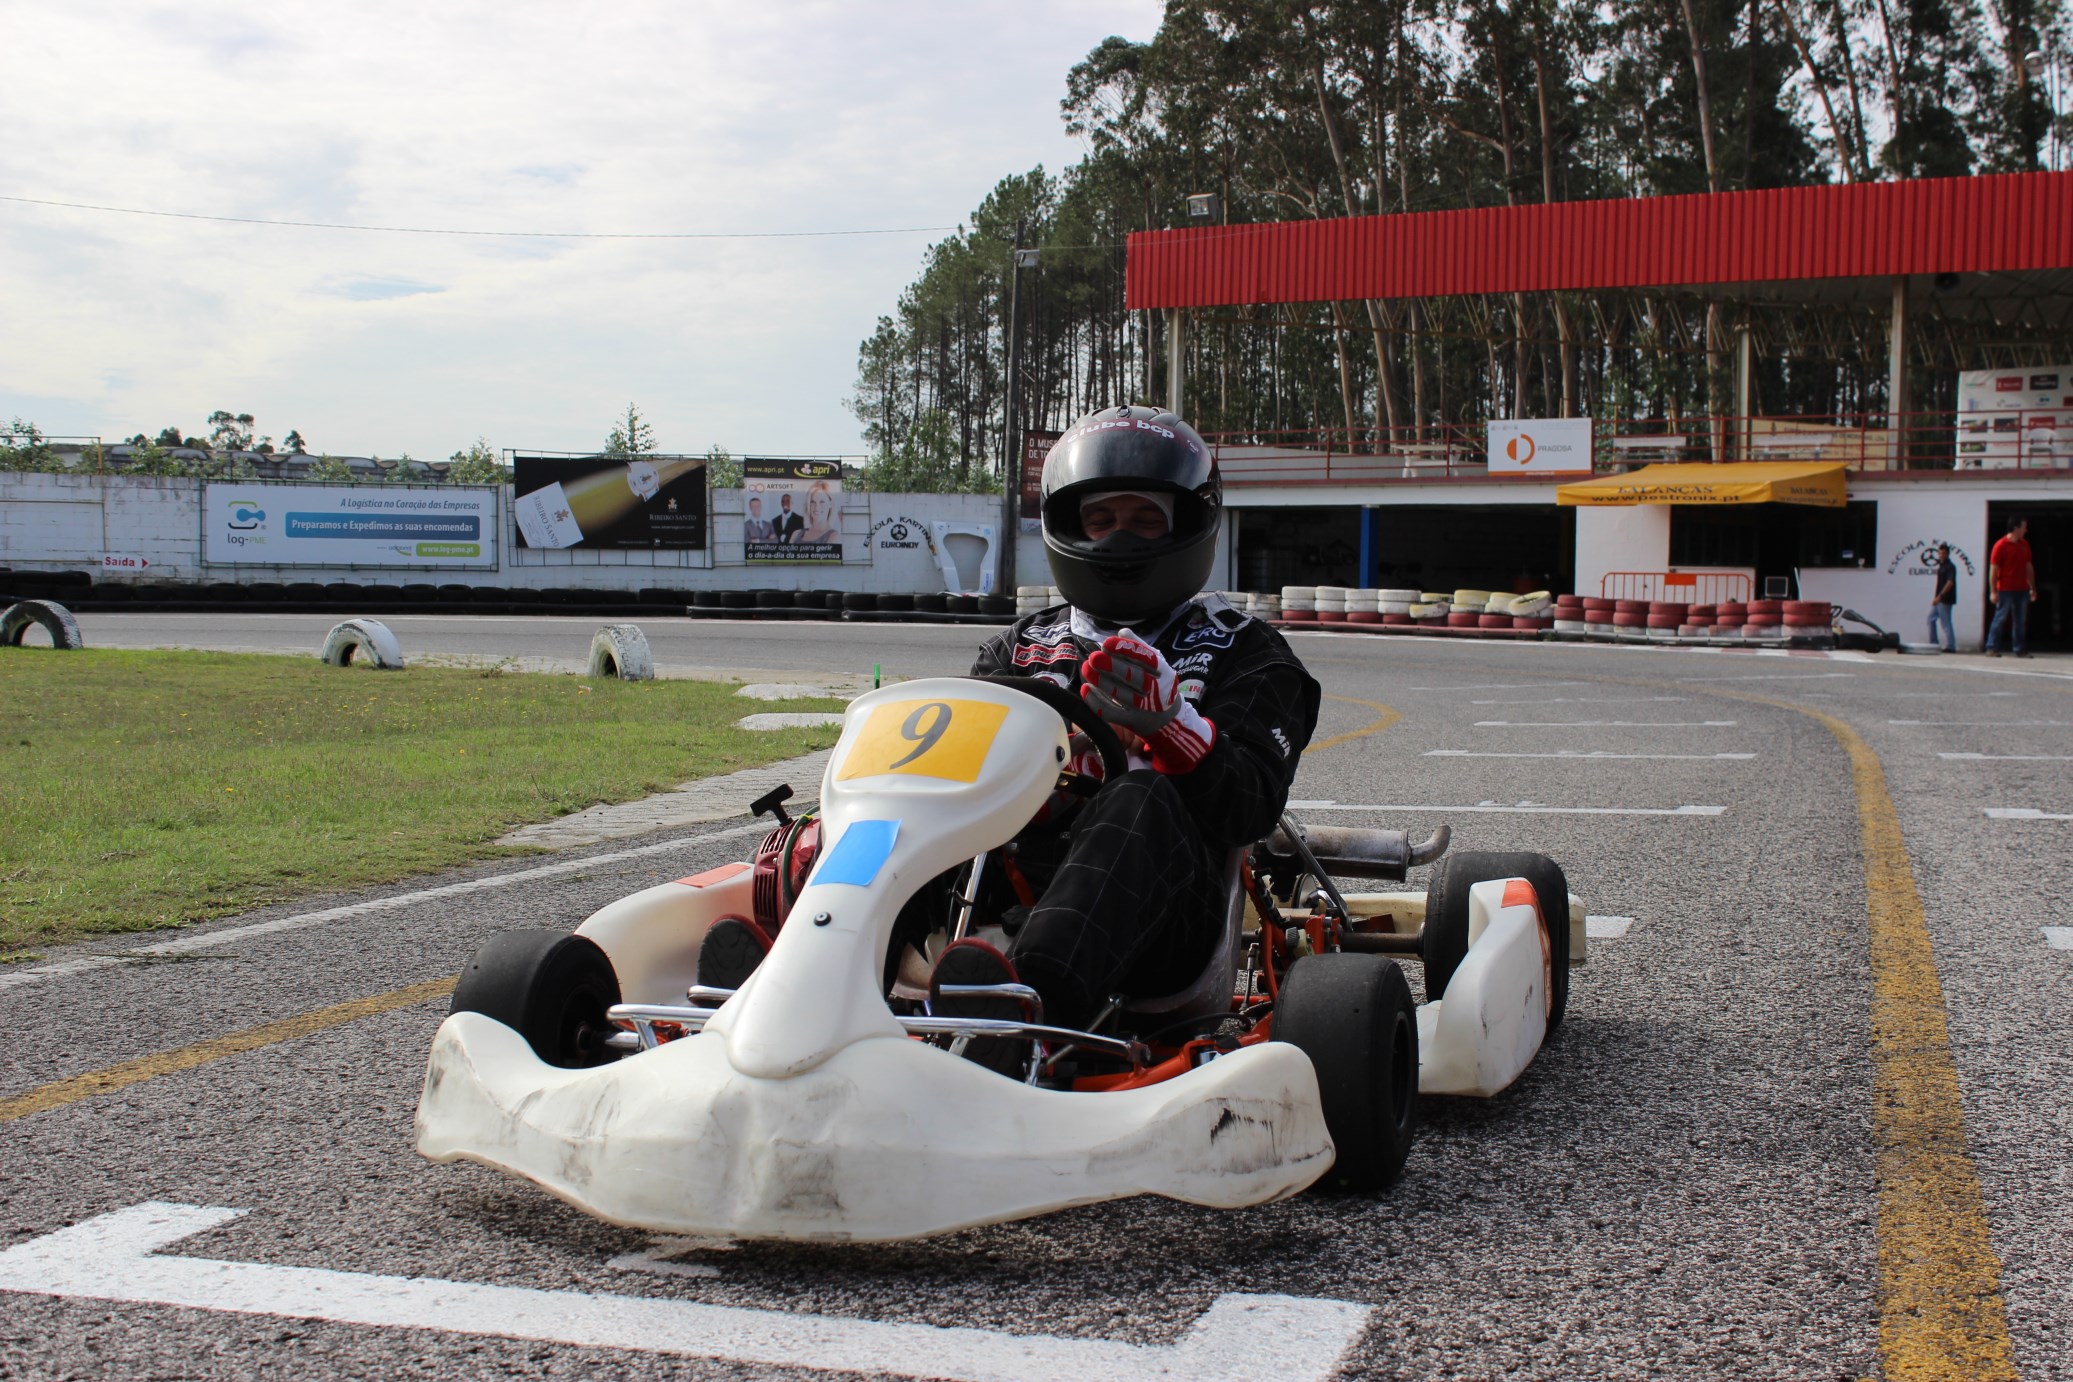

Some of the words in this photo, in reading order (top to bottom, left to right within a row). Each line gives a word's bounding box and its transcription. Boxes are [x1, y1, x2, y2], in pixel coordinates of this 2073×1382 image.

[1137, 419, 1175, 439] bcp
[1029, 437, 1036, 448] O
[1028, 449, 1039, 459] DE
[747, 466, 785, 474] www.apri.pt
[813, 464, 830, 476] apri
[341, 498, 346, 507] A
[347, 499, 382, 510] Logística
[396, 500, 427, 511] Coração
[428, 500, 441, 509] das
[443, 501, 480, 511] Empresas
[292, 519, 341, 531] Preparamos
[350, 520, 394, 532] Expedimos
[424, 523, 474, 532] encomendas
[545, 524, 560, 547] SANTO
[864, 517, 894, 548] ESCOLA
[228, 533, 267, 547] log-PME
[881, 541, 919, 549] EUROINDY
[105, 556, 134, 567] Saída
[1888, 540, 1925, 574] ESCOLA
[889, 702, 953, 770] 9
